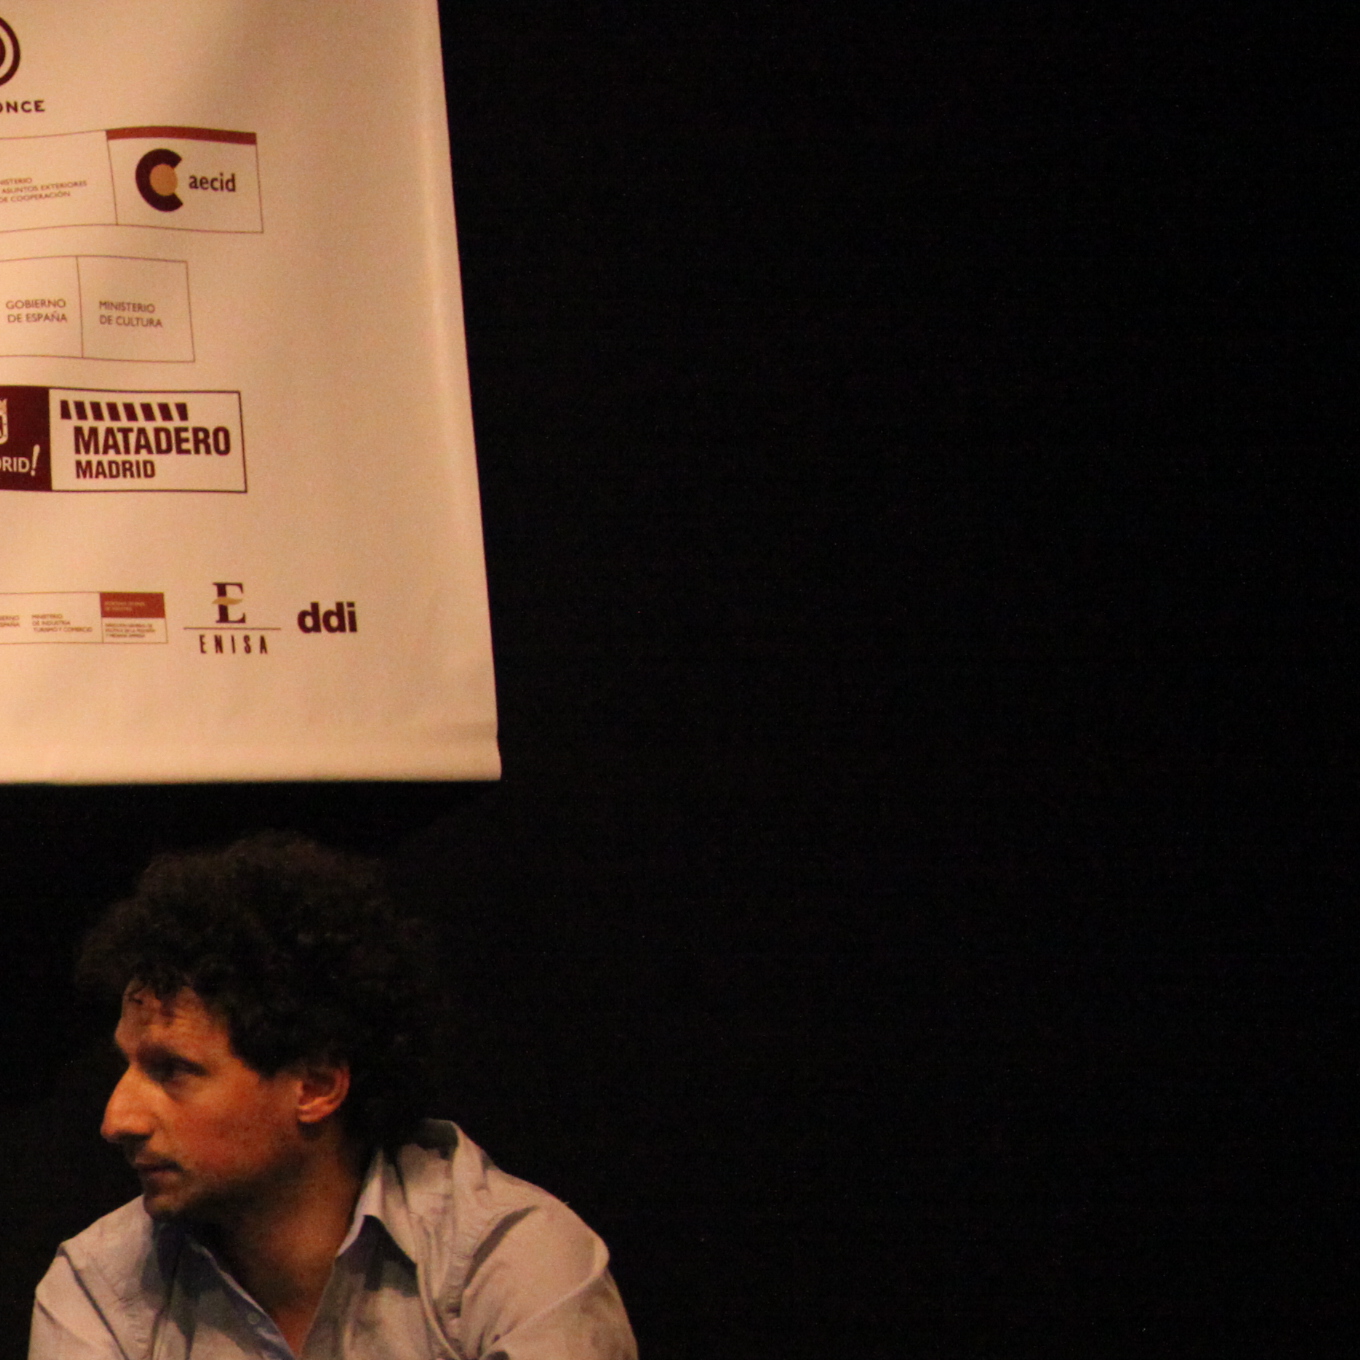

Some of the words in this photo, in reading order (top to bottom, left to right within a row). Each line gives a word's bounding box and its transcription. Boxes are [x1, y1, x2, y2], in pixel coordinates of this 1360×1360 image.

[189, 173, 236, 192] aecid
[5, 298, 66, 310] GOBIERNO
[98, 300, 156, 313] MINISTERIO
[7, 314, 25, 324] DE
[26, 310, 68, 324] ESPAÑA
[99, 315, 114, 326] DE
[115, 316, 163, 328] CULTURA
[74, 426, 230, 455] MATADERO
[76, 460, 155, 478] MADRID
[298, 602, 357, 633] ddi
[200, 635, 267, 653] ENISA
